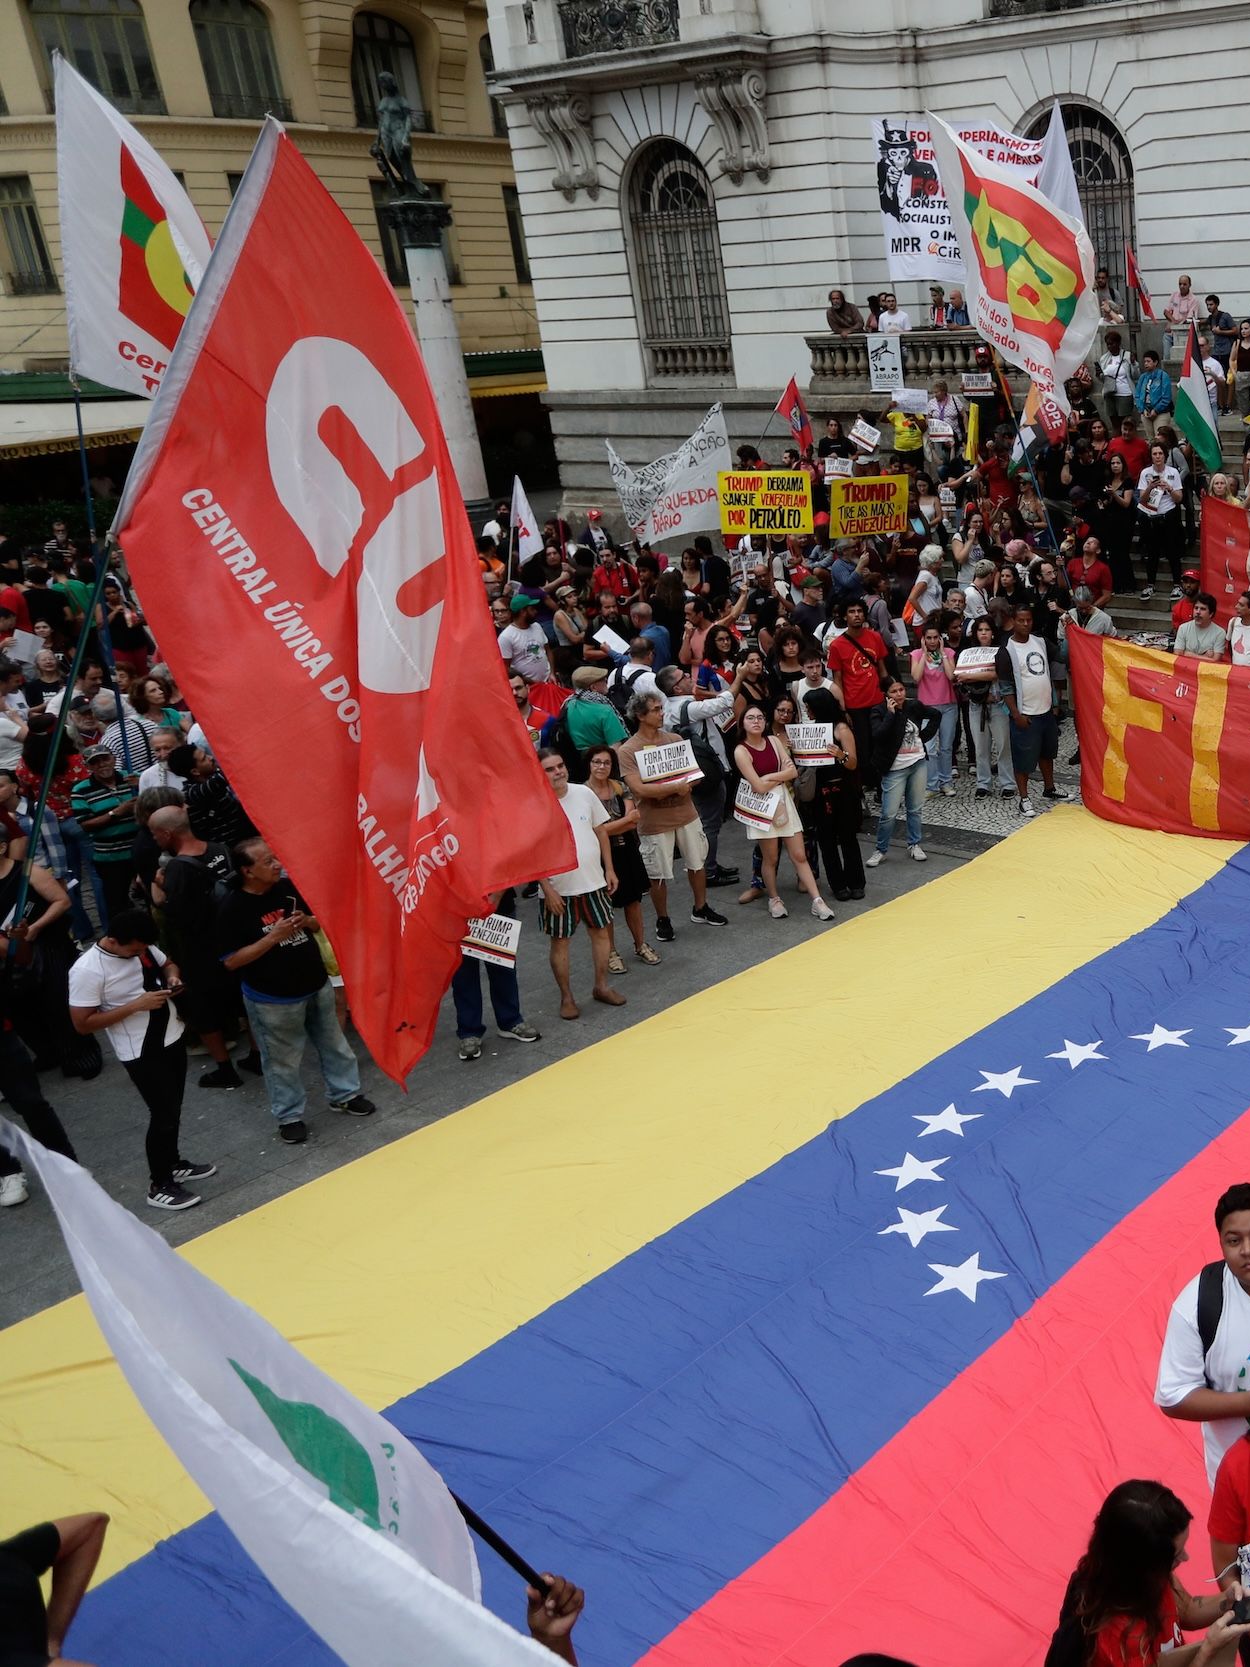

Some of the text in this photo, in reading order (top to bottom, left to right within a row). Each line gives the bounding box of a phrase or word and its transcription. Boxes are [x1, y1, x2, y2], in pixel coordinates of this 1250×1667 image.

[891, 238, 921, 253] MPR
[45, 433, 131, 454] CINEANDIA
[725, 476, 804, 492] TRUMP DERRAMA
[841, 481, 897, 502] TRUMP
[723, 492, 807, 508] SANGUE VENEZUELANO
[727, 504, 806, 530] POR PETRÓLEO.
[837, 504, 855, 520] TIRE
[857, 504, 868, 518] AS
[182, 488, 362, 743] CENTRAL ÚNICA DOS
[802, 727, 827, 739] TRUMP
[797, 739, 827, 750] VENEZUELA
[643, 744, 686, 765] FORA TRUMP
[646, 757, 690, 777] DA VENEZUELA
[740, 781, 750, 795] ORA
[743, 797, 769, 814] VENEZUELA
